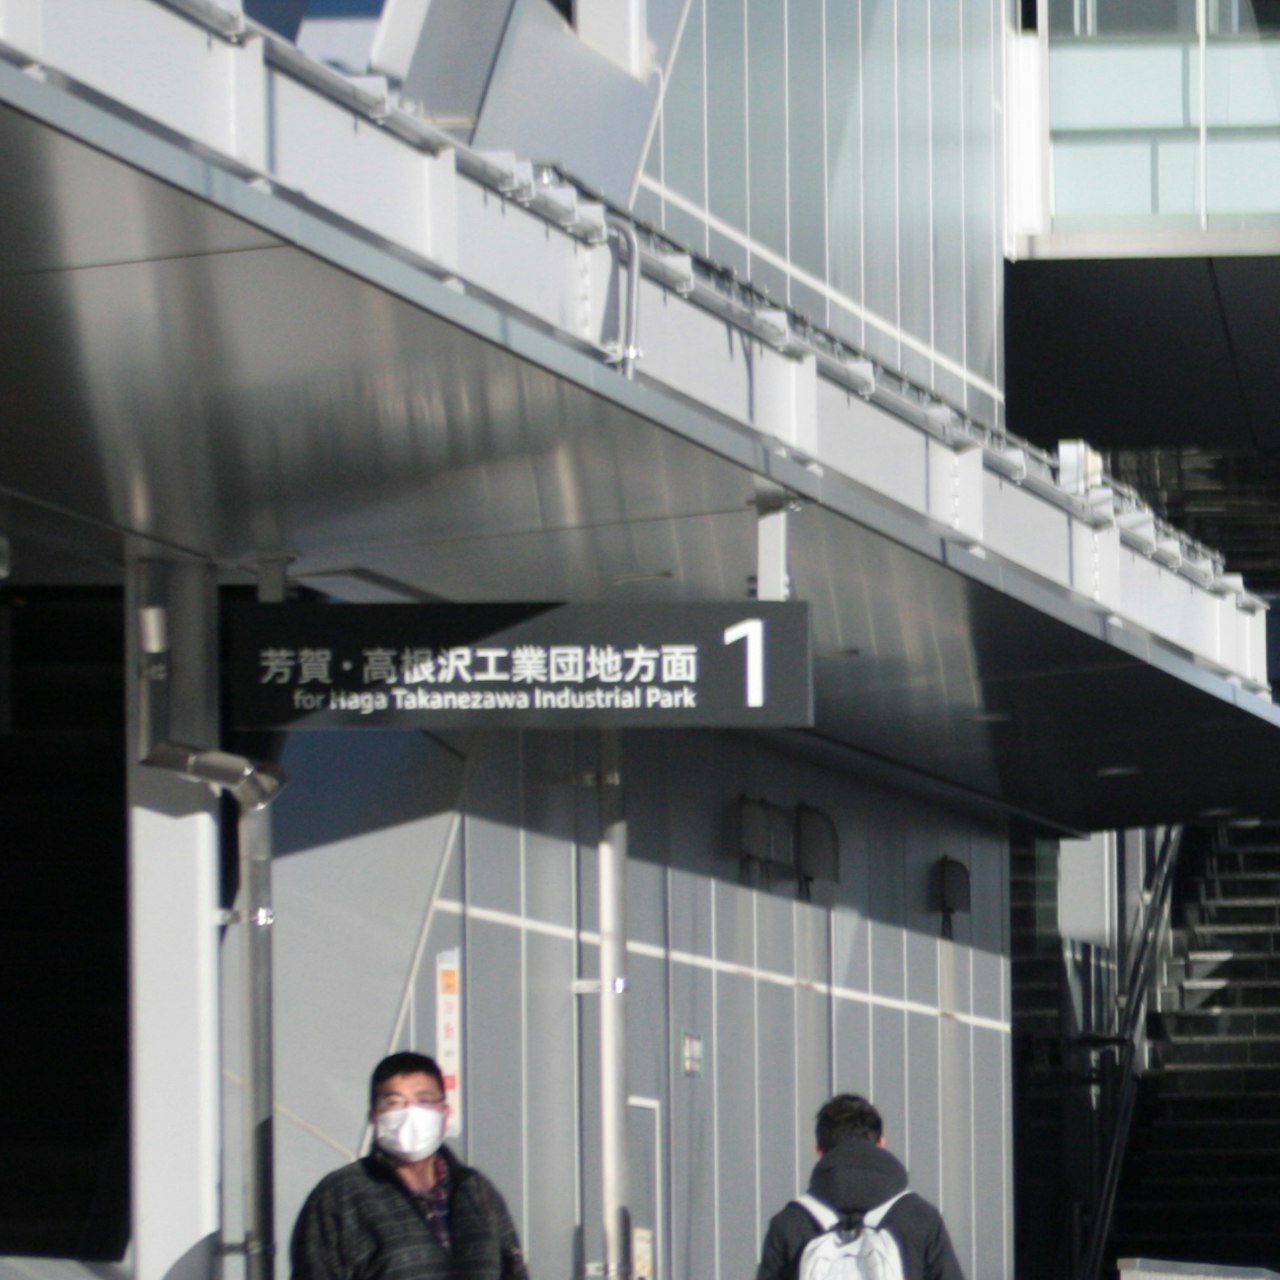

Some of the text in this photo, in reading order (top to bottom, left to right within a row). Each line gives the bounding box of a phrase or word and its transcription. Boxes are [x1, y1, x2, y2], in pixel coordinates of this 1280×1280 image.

[260, 645, 698, 684] 芳賀・高根沢工業団地方面
[723, 618, 764, 707] 1
[294, 686, 697, 714] for Haga Takanezawa Industrial Park
